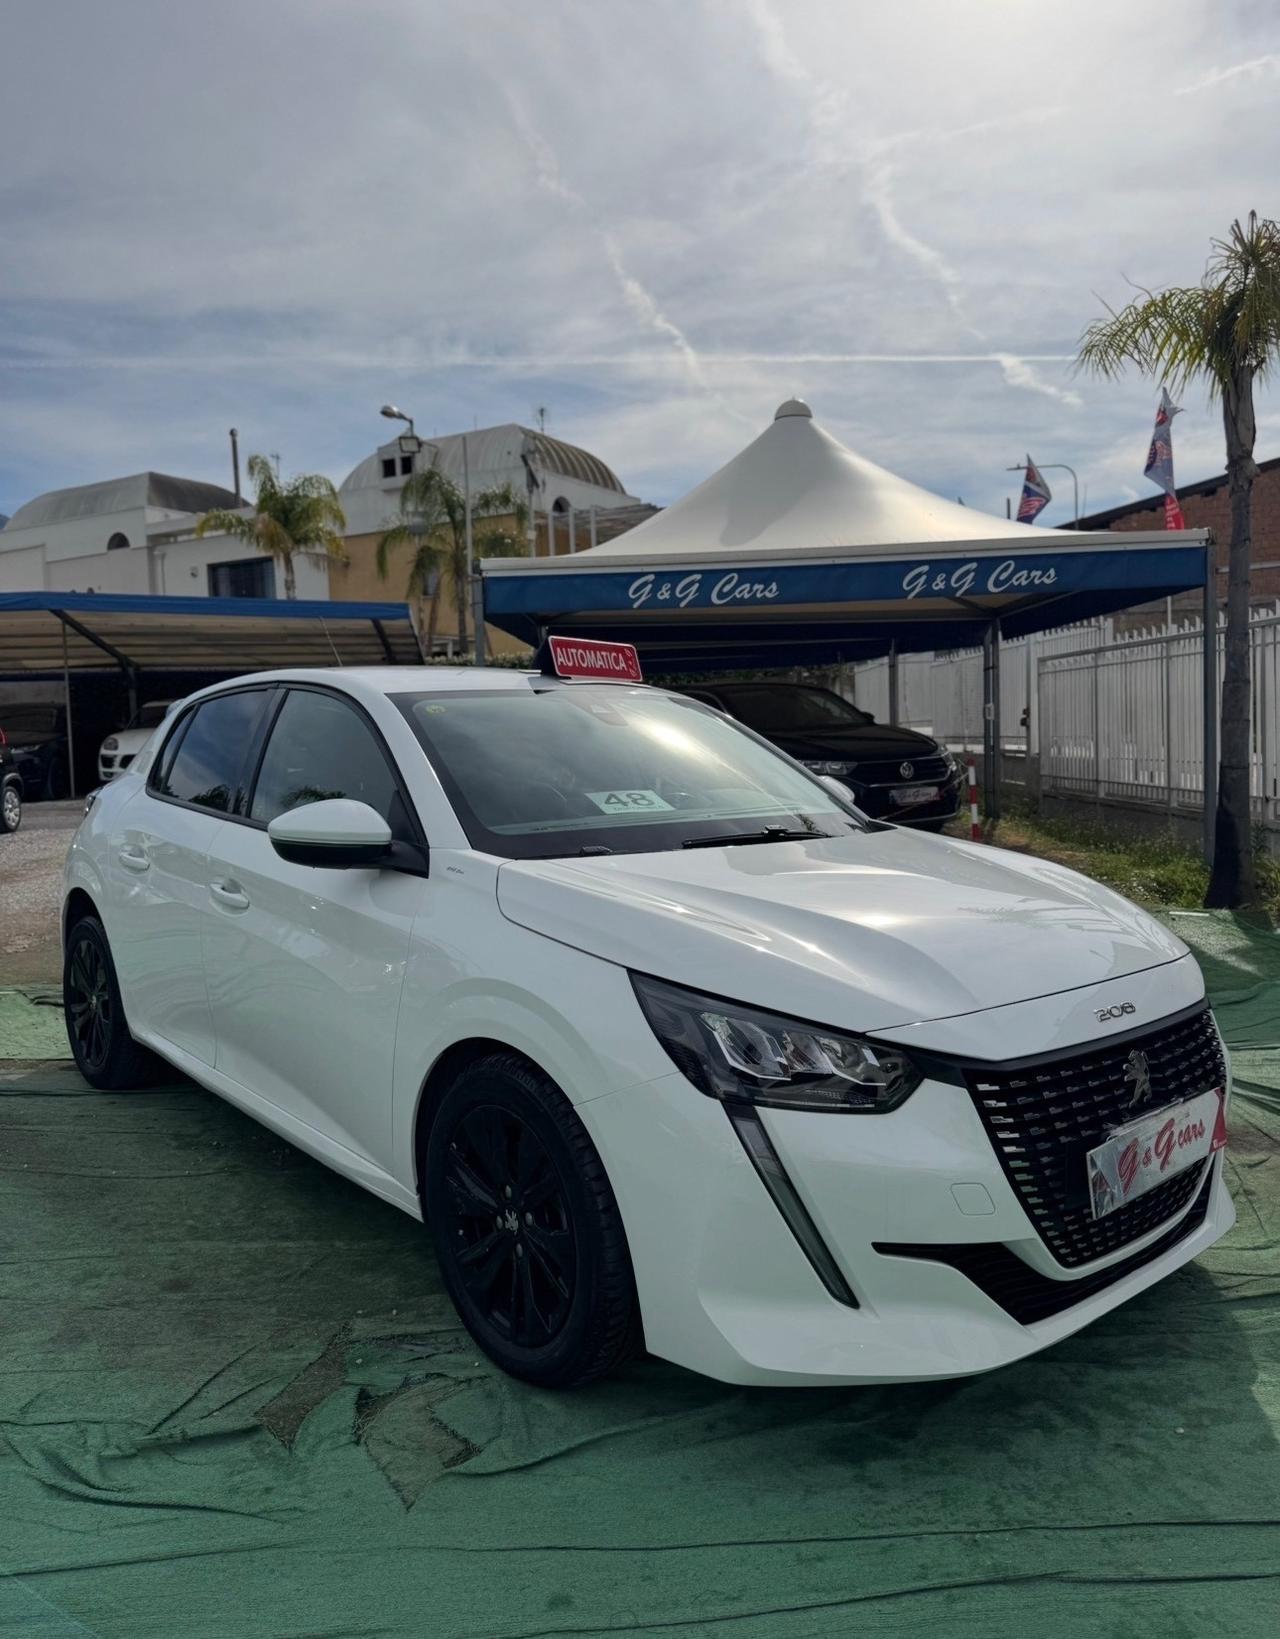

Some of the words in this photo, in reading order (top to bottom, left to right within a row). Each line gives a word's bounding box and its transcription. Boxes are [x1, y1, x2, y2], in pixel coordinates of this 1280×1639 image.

[987, 560, 1058, 593] Cars
[711, 573, 780, 605] Cars
[556, 647, 627, 671] AUTOMATICA
[604, 792, 655, 806] 48
[1094, 1002, 1136, 1022] 208
